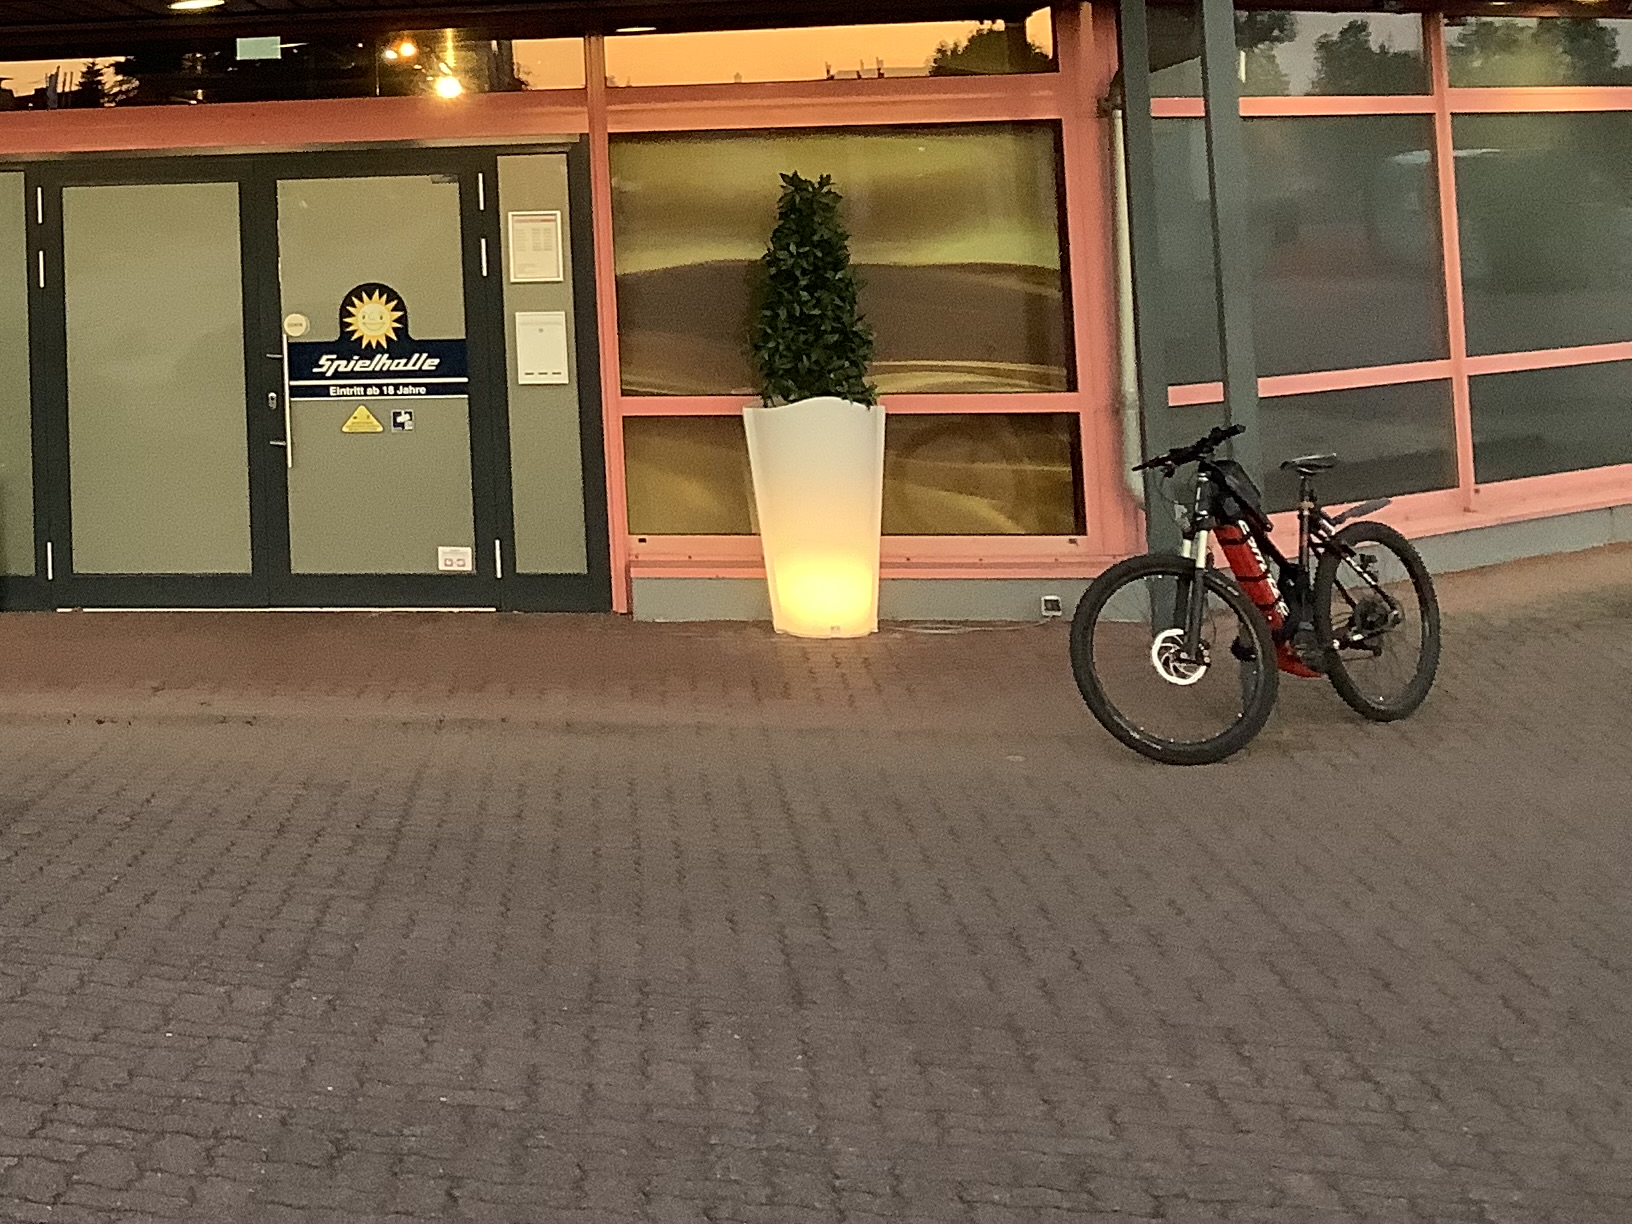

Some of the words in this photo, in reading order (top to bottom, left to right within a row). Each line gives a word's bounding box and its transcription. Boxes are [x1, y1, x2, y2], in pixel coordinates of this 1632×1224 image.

[312, 352, 440, 376] Spielhalle
[329, 386, 365, 396] Eintritt
[366, 385, 380, 395] ab
[382, 385, 395, 395] 18
[396, 384, 427, 395] Jahre
